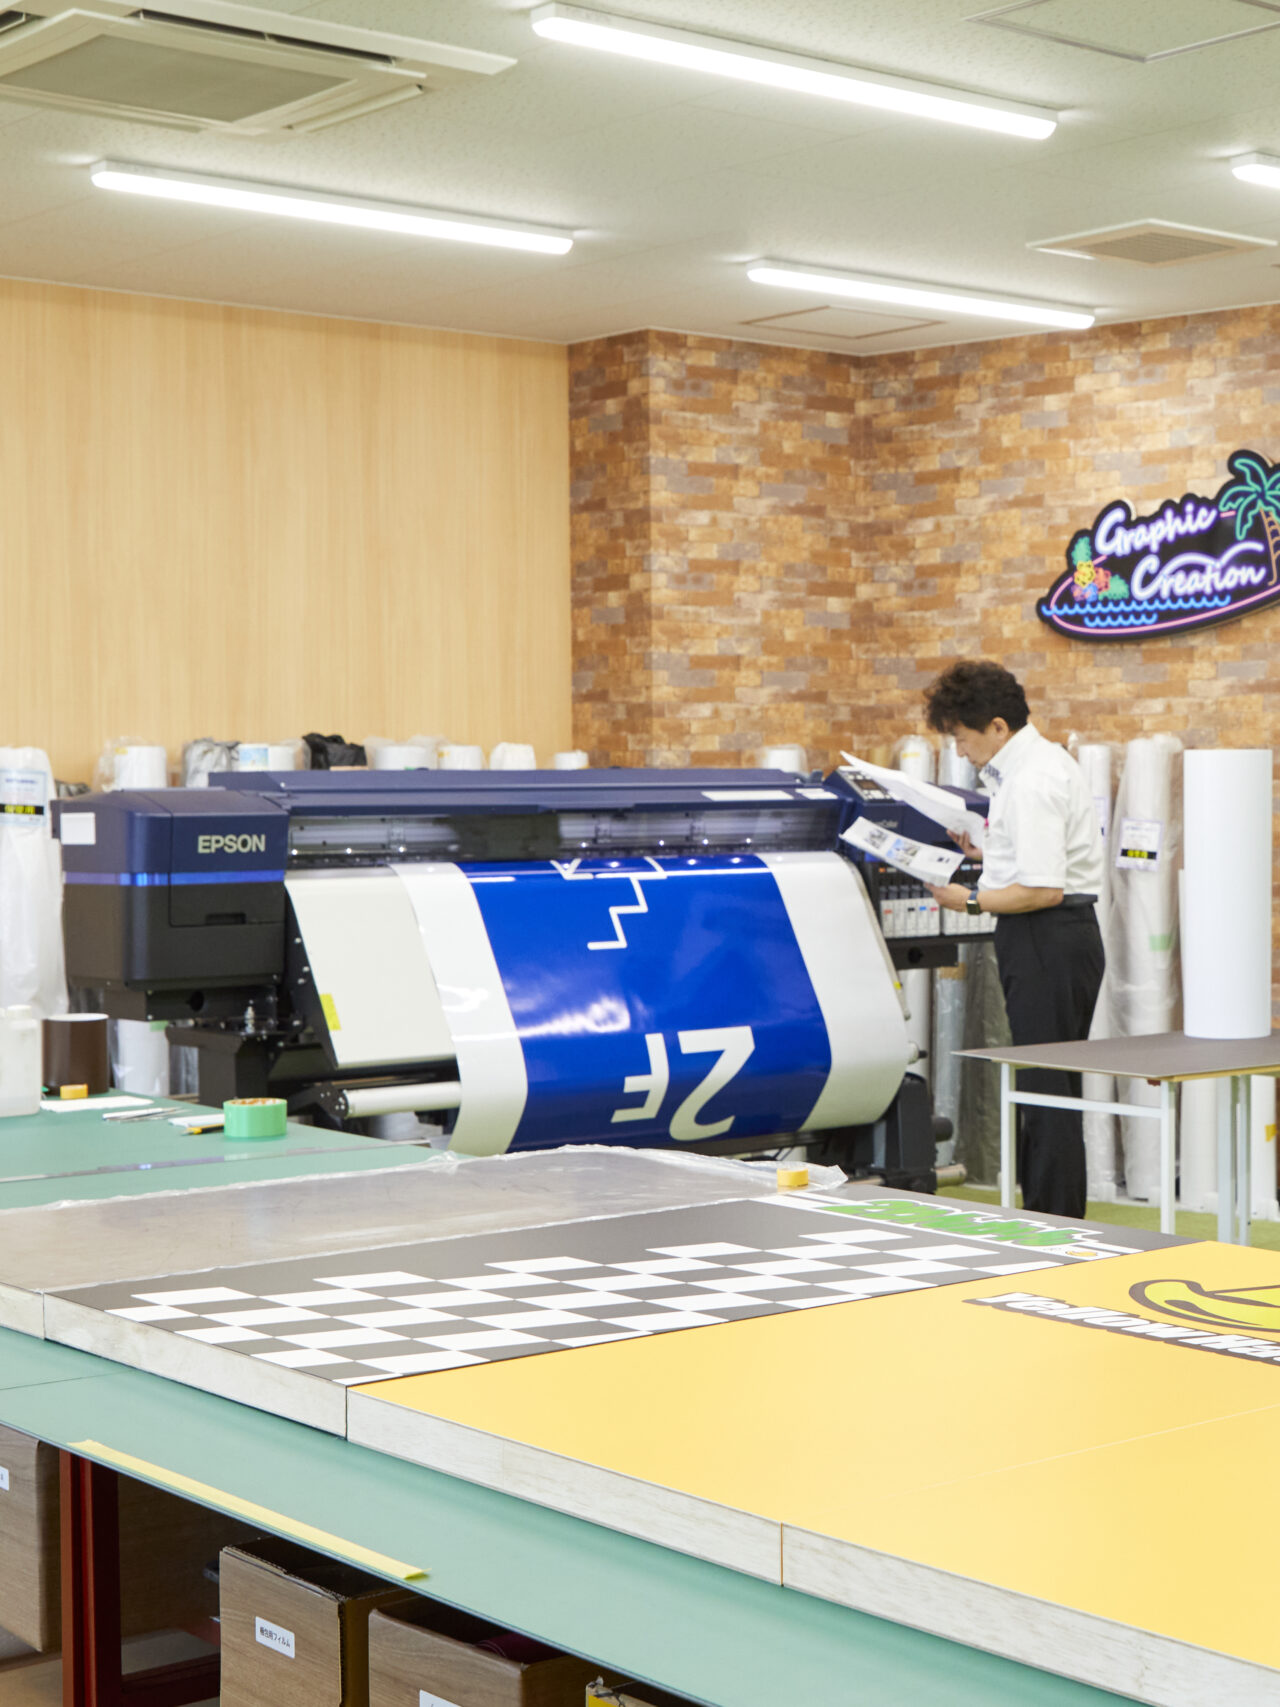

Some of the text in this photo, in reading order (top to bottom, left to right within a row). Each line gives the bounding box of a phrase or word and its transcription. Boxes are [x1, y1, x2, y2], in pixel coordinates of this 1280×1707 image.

[1094, 502, 1216, 557] Graphic
[1131, 541, 1266, 600] Creation
[197, 833, 266, 854] EPSON
[610, 1025, 755, 1141] 2F
